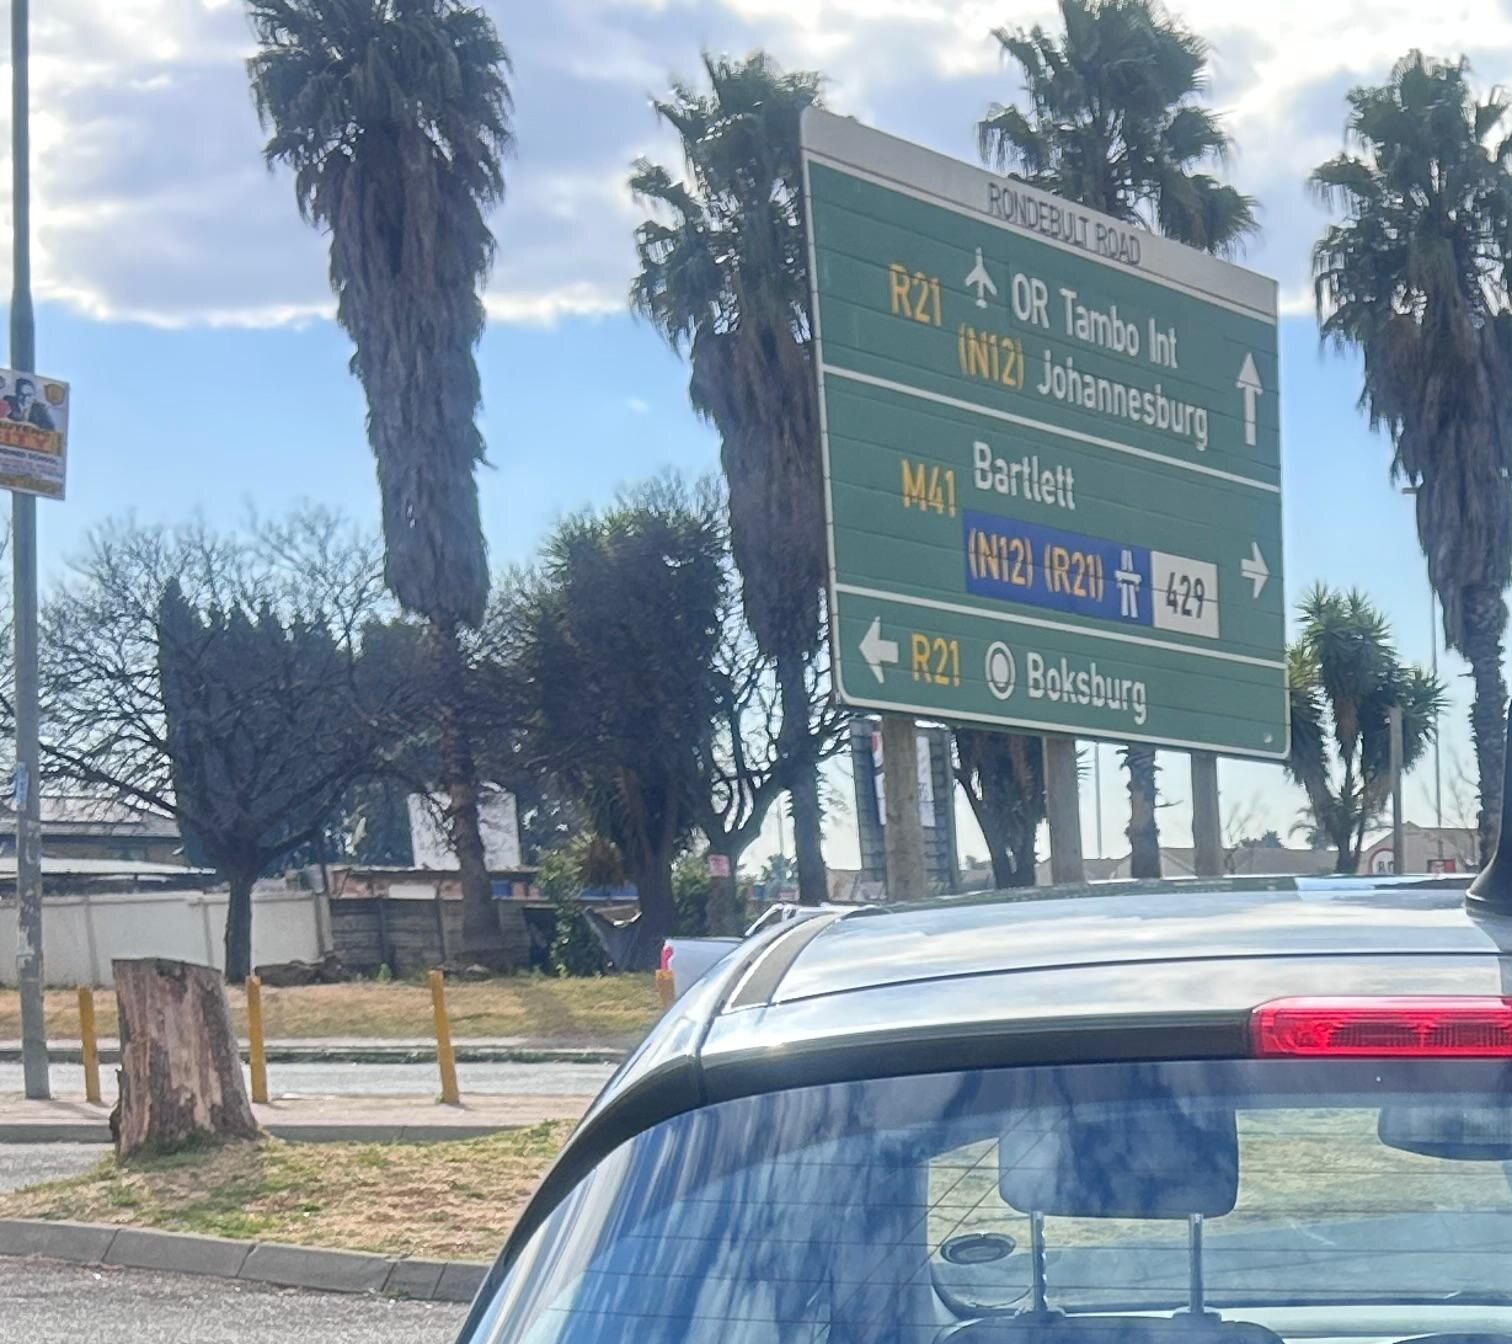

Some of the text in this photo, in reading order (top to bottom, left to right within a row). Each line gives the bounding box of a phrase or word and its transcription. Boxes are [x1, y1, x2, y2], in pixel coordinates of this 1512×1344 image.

[988, 182, 1142, 267] RONDEBULT ROAD
[888, 262, 1179, 370] R21 OR Tambo Int
[957, 322, 1209, 452] (N12) Johannesburg
[901, 440, 1076, 517] M41 Bartlett
[968, 527, 1205, 620] (N12) (R21) 429
[911, 632, 1147, 725] R21 Boksburg
